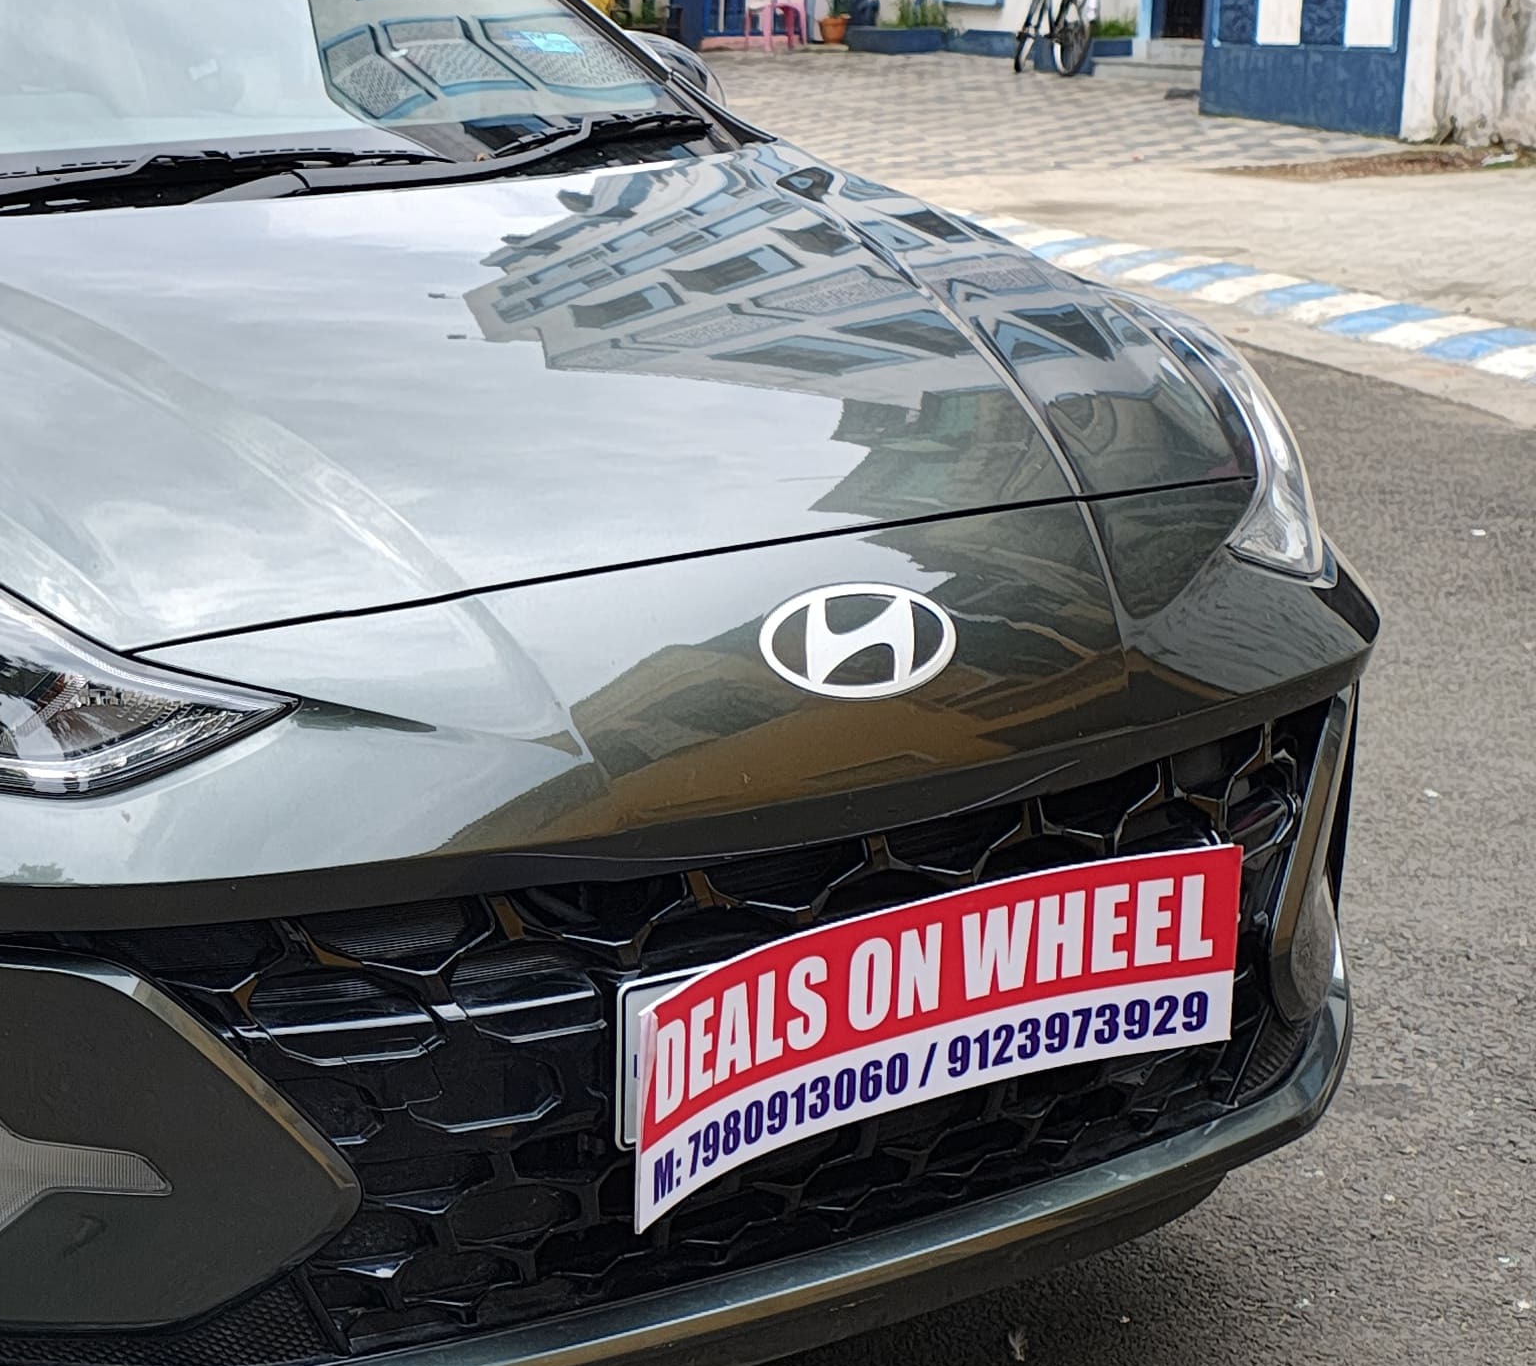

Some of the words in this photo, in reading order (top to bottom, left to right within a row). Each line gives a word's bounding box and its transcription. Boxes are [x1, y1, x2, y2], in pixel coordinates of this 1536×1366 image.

[653, 1147, 682, 1205] M:
[687, 1052, 909, 1179] 7980913060
[918, 1041, 939, 1089] /
[947, 990, 1209, 1078] 9123973929
[654, 955, 828, 1125] DEALS
[848, 922, 943, 1032] ON
[962, 873, 1214, 1001] WHEEL
